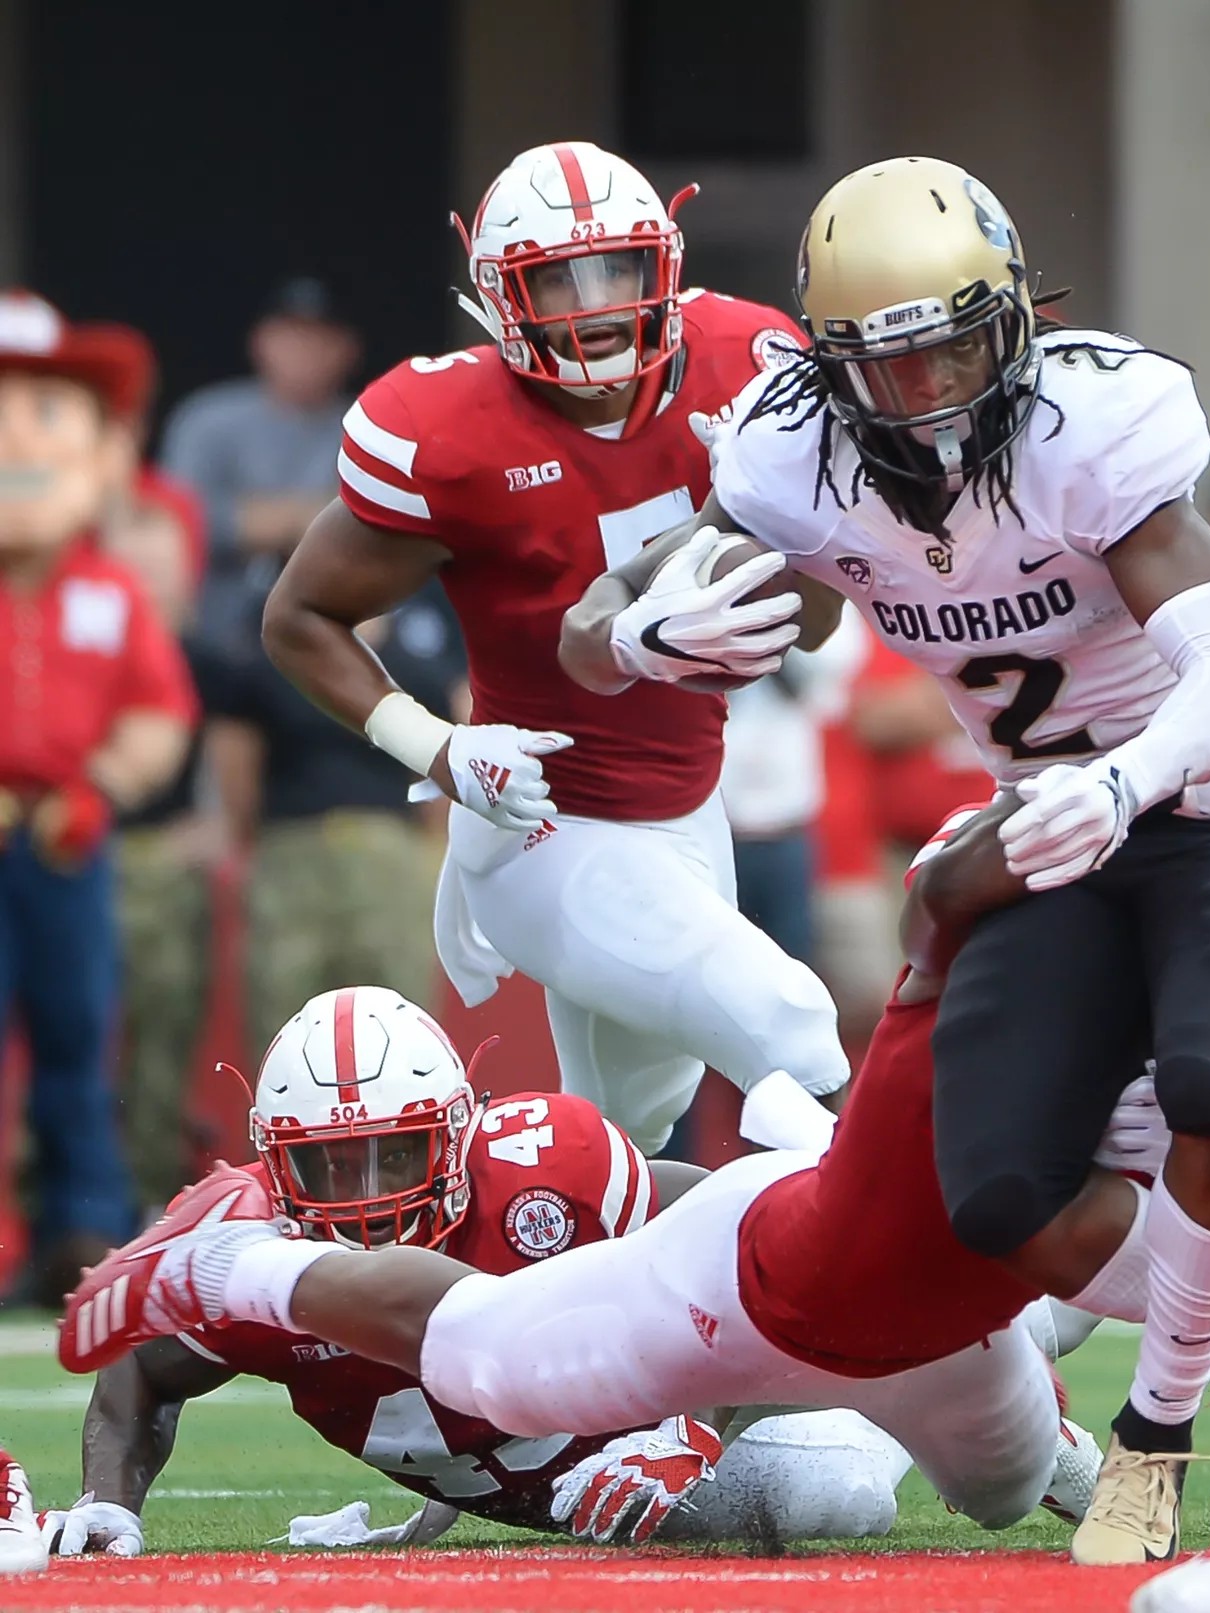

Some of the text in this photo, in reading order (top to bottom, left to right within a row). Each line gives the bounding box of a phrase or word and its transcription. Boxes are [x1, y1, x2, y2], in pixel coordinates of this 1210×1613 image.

[571, 222, 605, 240] 623
[884, 305, 924, 327] BUFFS
[871, 578, 1077, 643] COLORADO
[956, 653, 1099, 761] 2
[469, 759, 499, 808] adidas
[330, 1104, 368, 1123] 504
[481, 1098, 553, 1167] 43
[519, 1215, 562, 1235] HUSKERS
